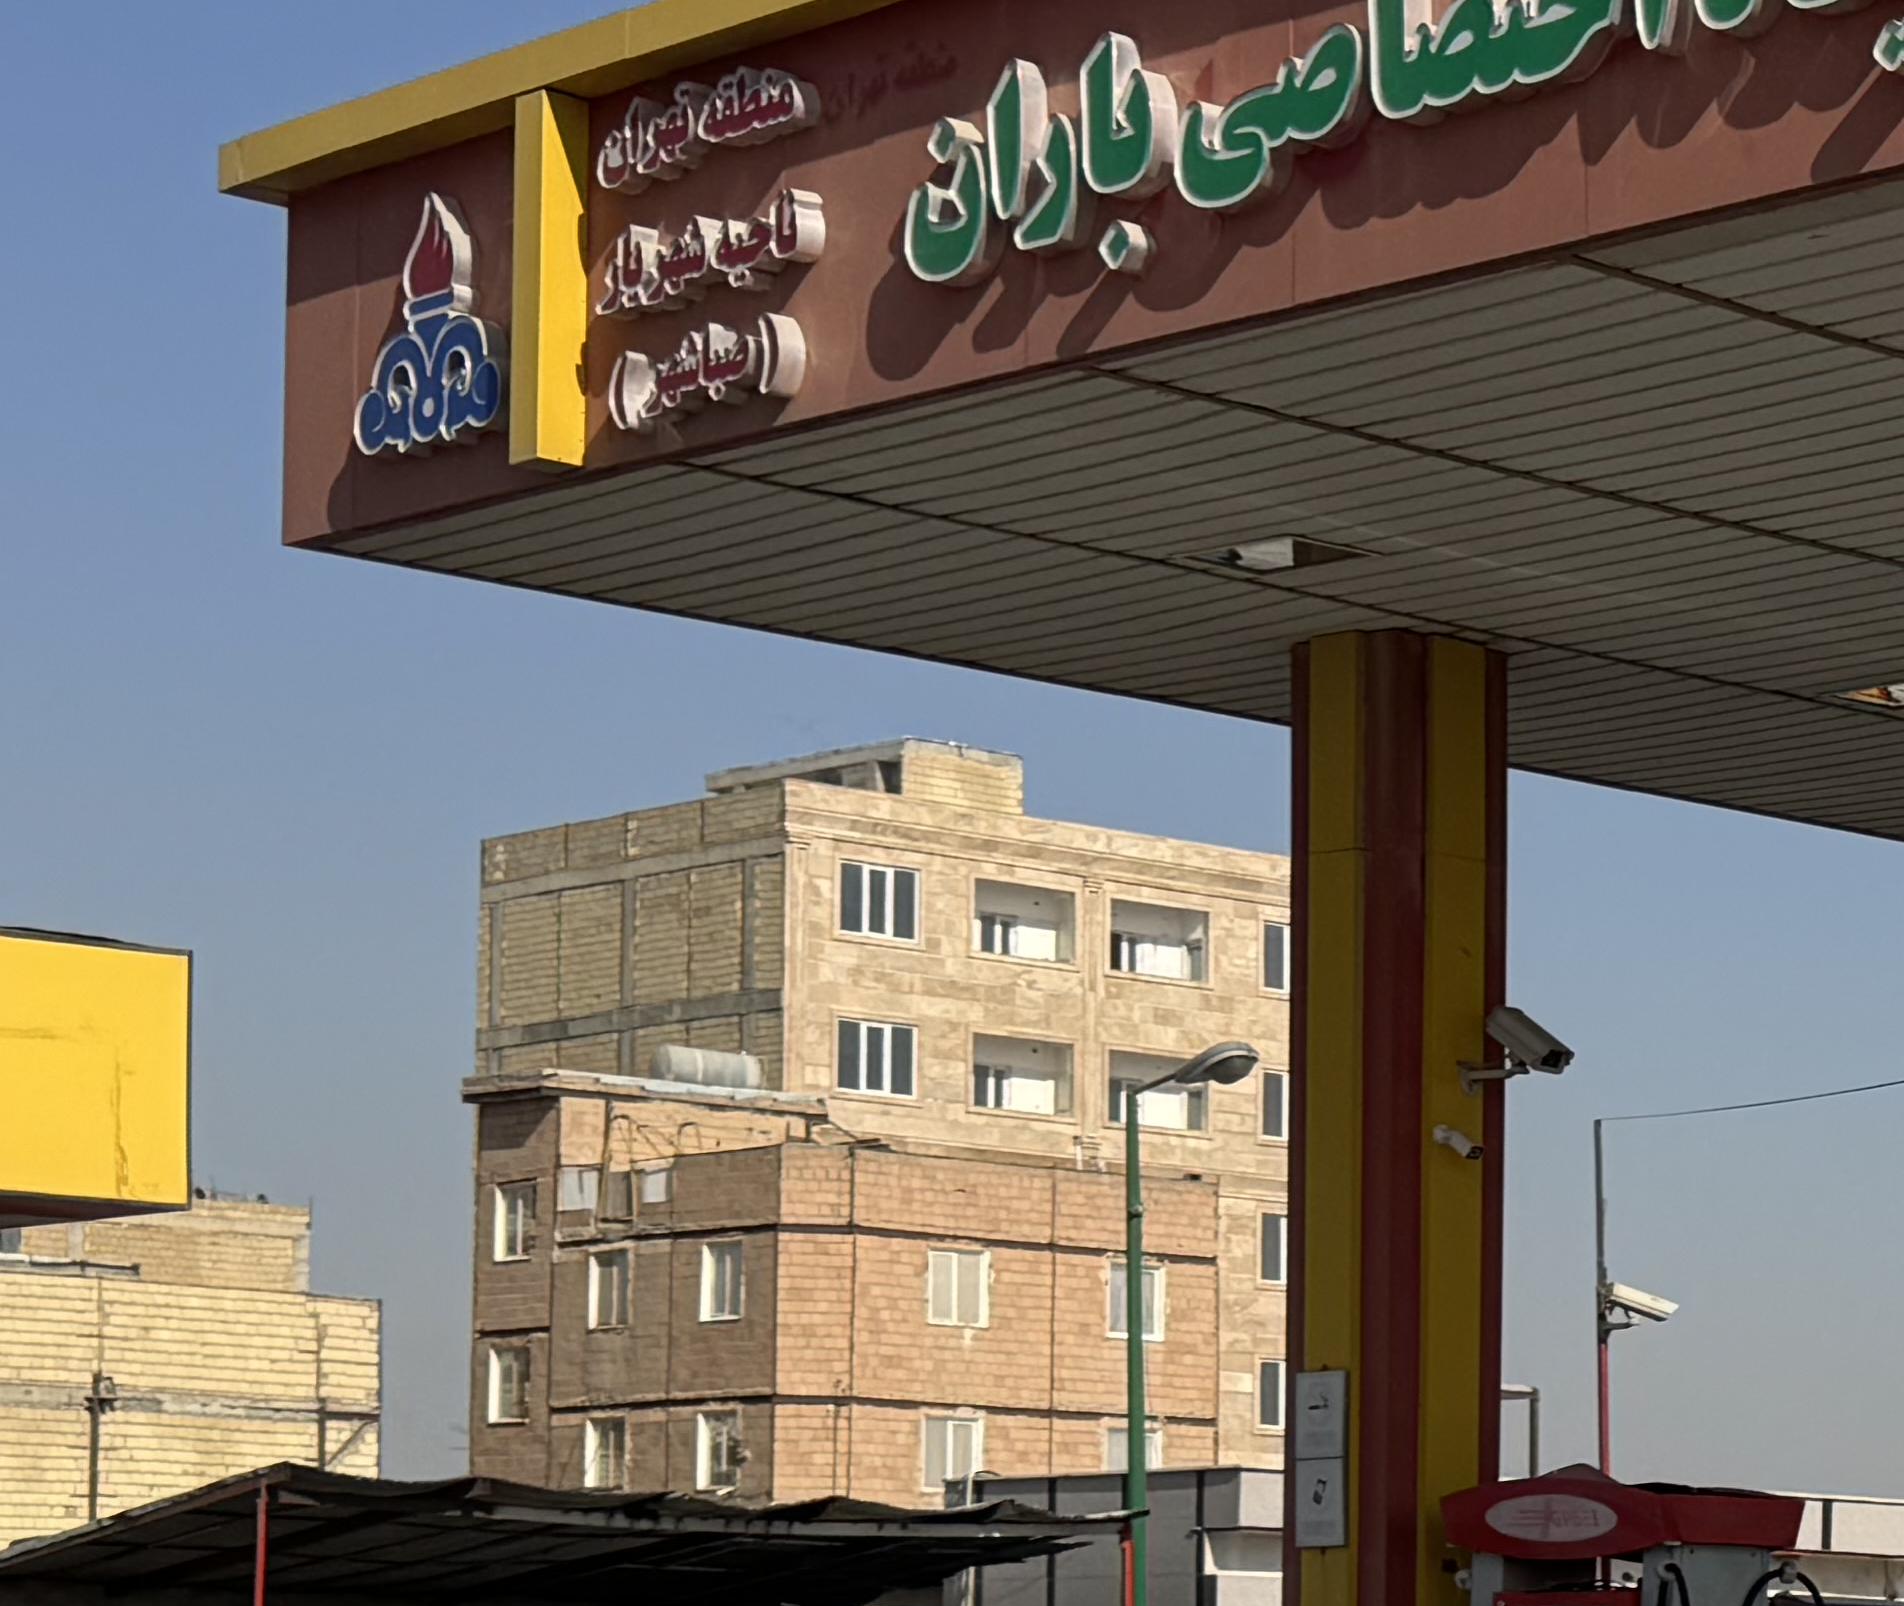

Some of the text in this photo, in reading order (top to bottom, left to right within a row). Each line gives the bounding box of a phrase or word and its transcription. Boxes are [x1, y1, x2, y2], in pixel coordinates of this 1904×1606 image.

[597, 66, 808, 190] منطقه تهران
[905, 30, 1165, 284] باران
[595, 187, 800, 316] ناحیه شهریار
